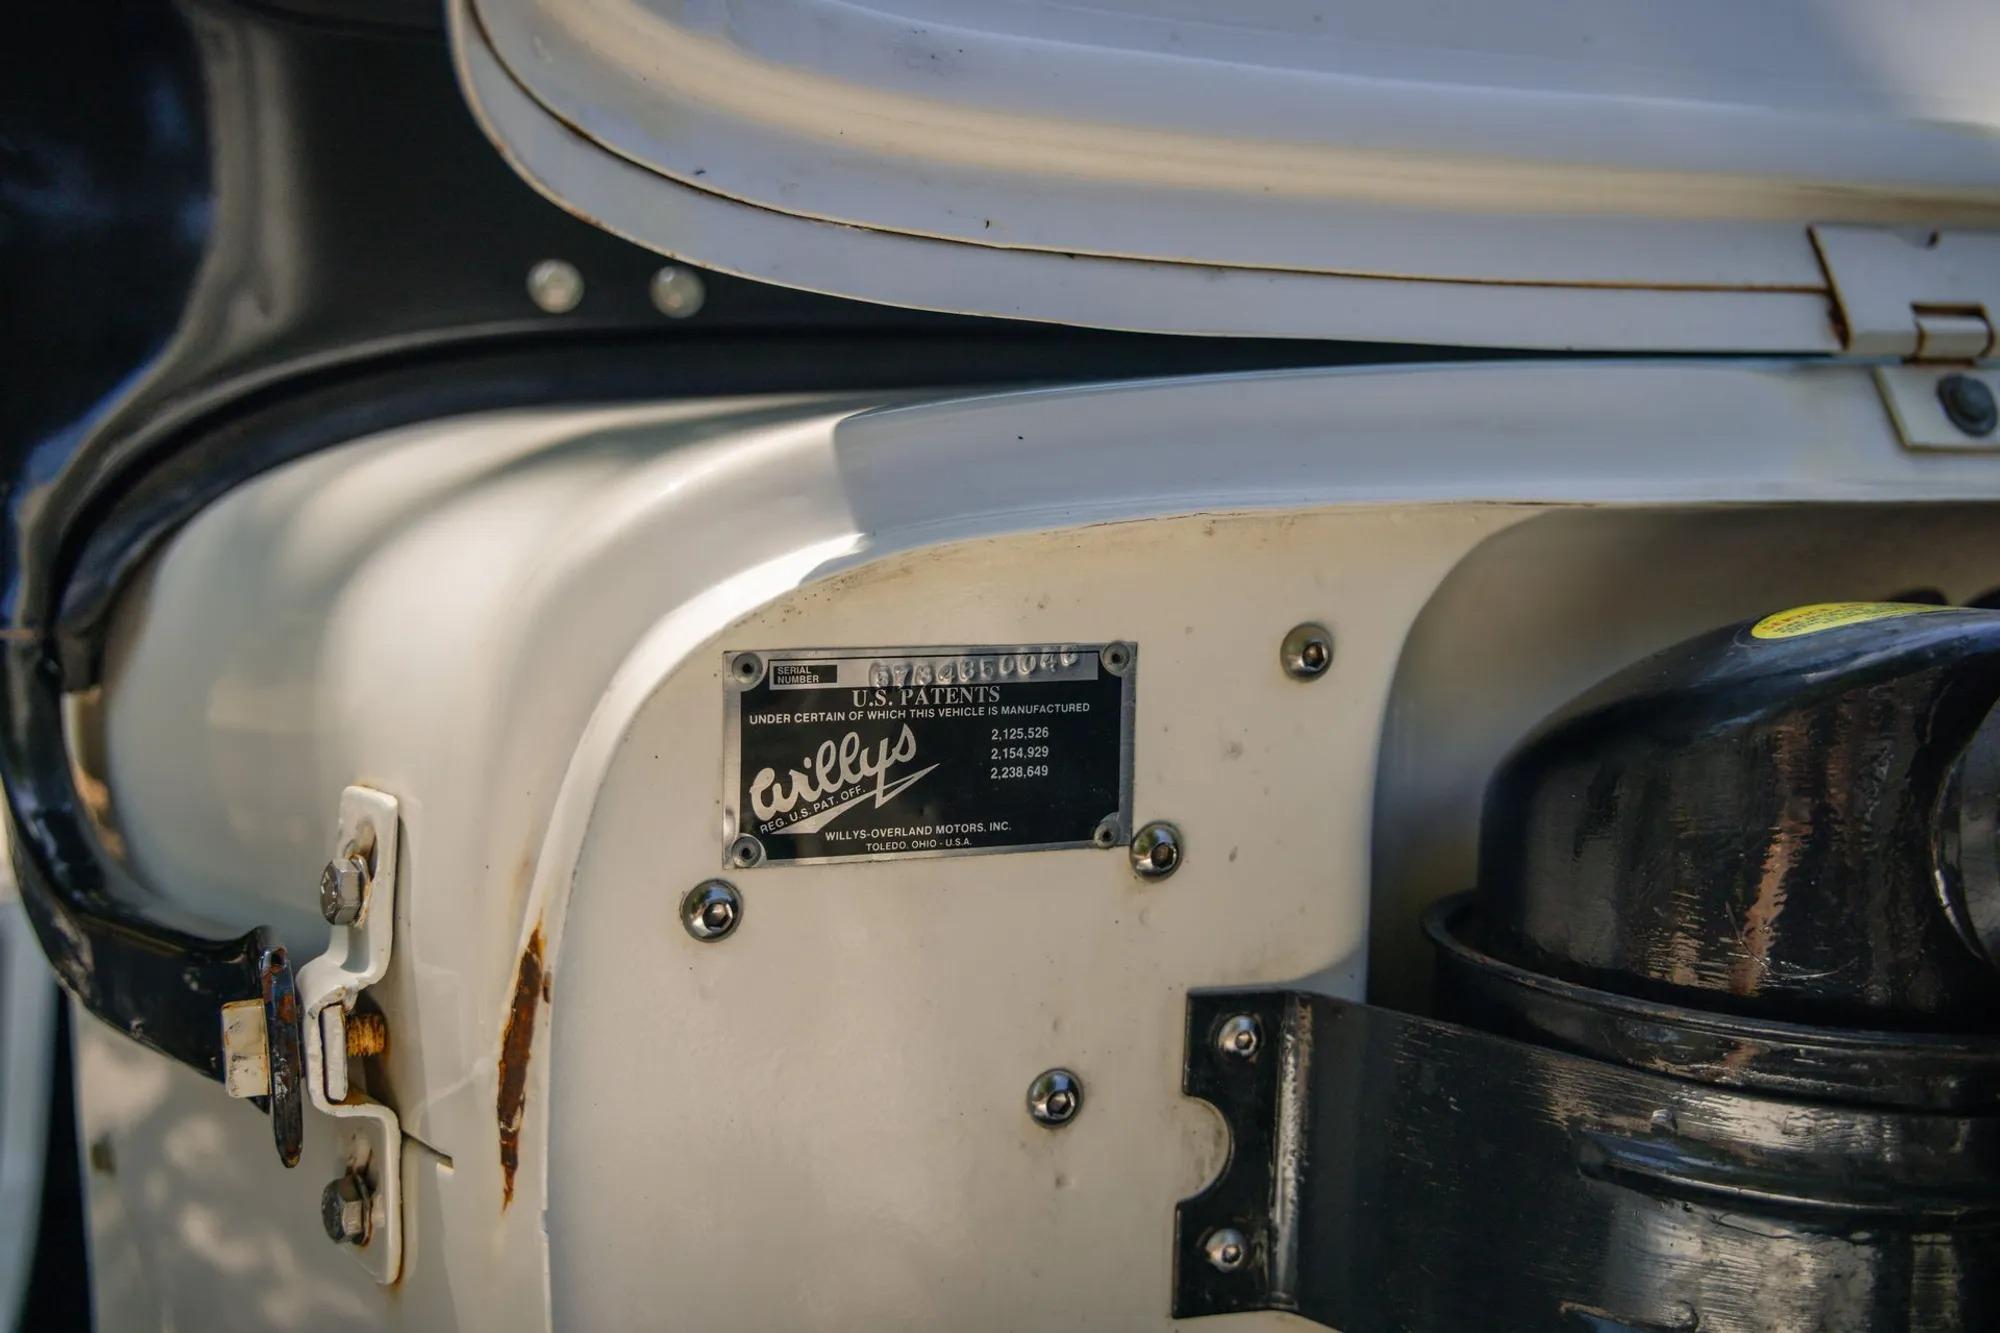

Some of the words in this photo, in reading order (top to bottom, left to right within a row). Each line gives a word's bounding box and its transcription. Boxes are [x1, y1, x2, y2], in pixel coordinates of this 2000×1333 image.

[777, 667, 812, 675] SERIAL
[777, 675, 820, 685] NUMBER
[852, 689, 893, 707] U.S.
[900, 686, 1001, 706] PATENTS
[749, 714, 791, 725] UNDER
[794, 712, 846, 723] CERTAIN
[848, 710, 864, 721] OF
[867, 709, 906, 720] WHICH
[910, 708, 935, 718] THIS
[938, 706, 985, 717] VEHICLE
[988, 705, 999, 716] IS
[1001, 703, 1091, 715] MANUFACTURED
[990, 765, 1049, 780] 2,238,649
[759, 817, 788, 835] REG.
[789, 807, 812, 822] U.S.
[813, 796, 839, 813] PAT.
[840, 785, 866, 801] OFF.
[825, 825, 933, 841] WILLYS-OVERLAND
[990, 820, 1012, 832] INC.
[912, 839, 937, 850] OHIO
[945, 837, 972, 848] U.S.A.
